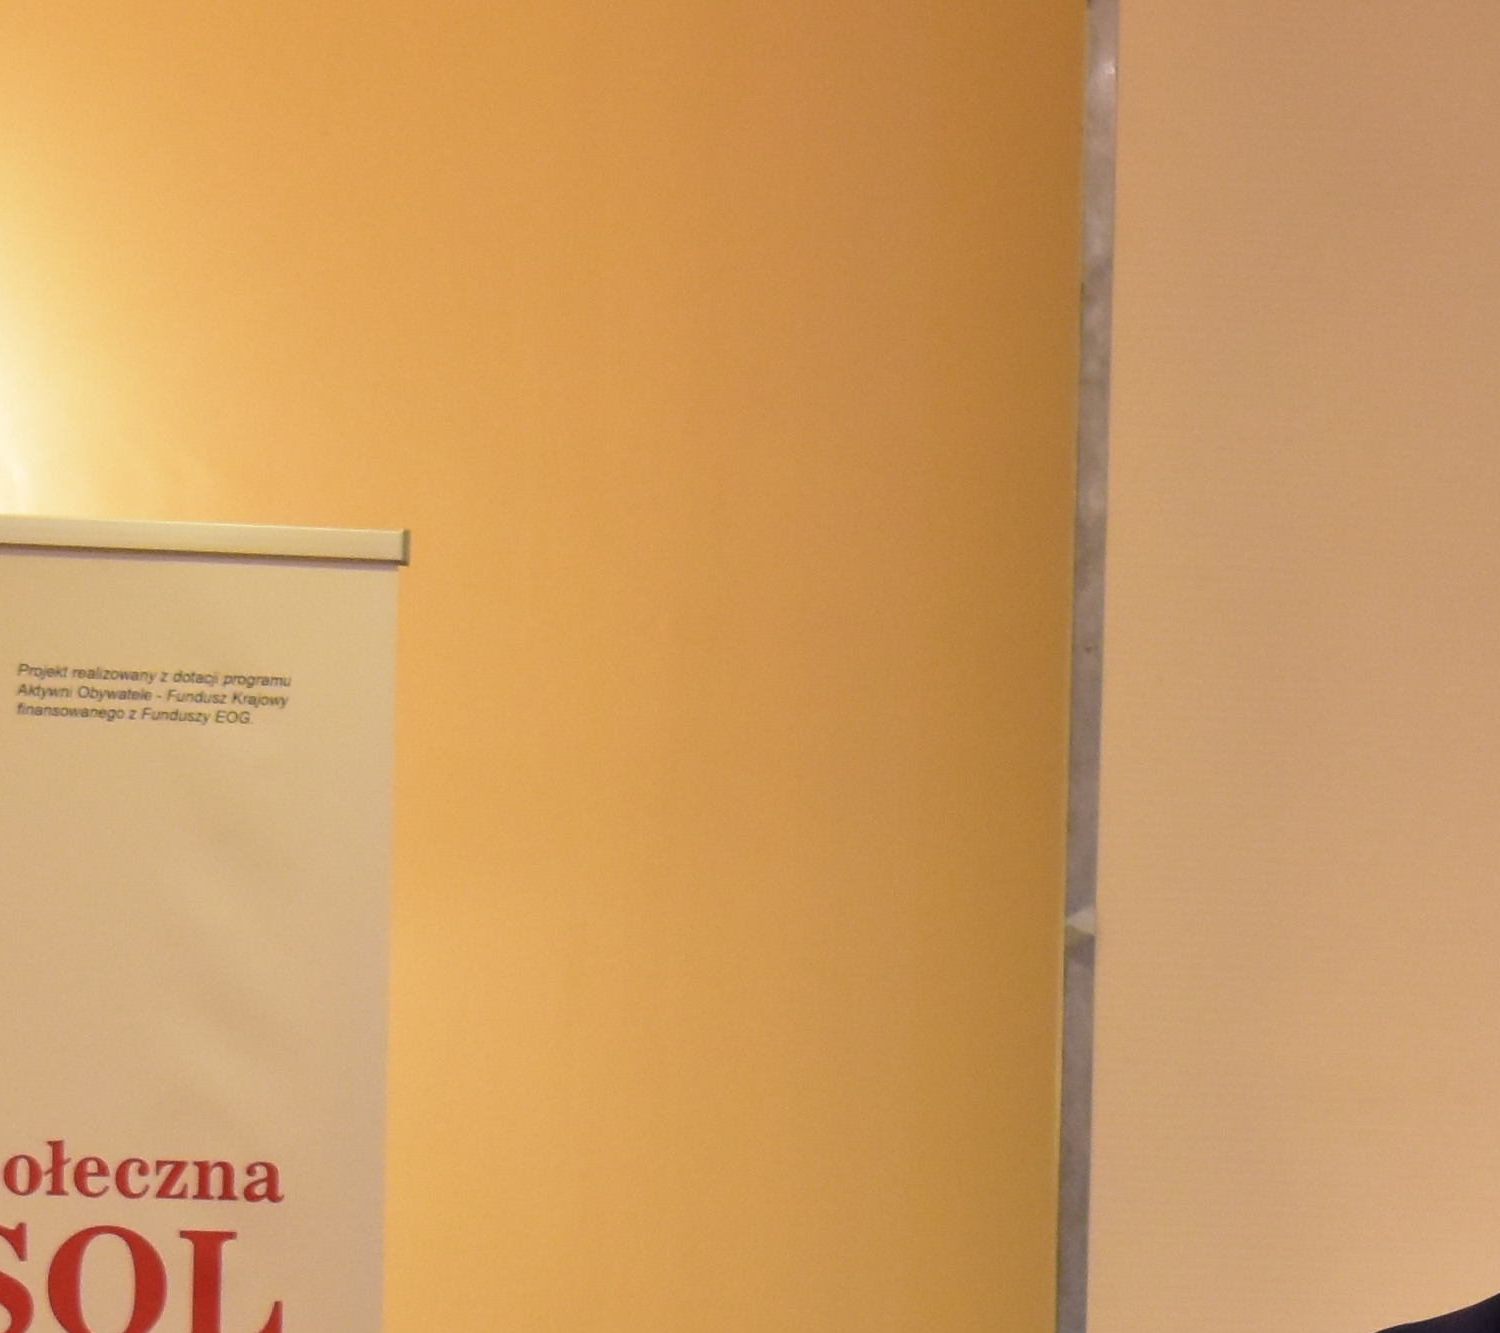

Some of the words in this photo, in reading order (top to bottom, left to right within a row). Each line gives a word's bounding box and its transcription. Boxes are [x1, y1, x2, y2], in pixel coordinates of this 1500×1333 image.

[18, 664, 67, 680] Projekt
[73, 667, 155, 684] realizowany
[160, 672, 167, 683] z
[174, 671, 219, 685] dotacji
[223, 673, 292, 688] programu
[18, 684, 73, 701] Aktywni
[78, 686, 152, 703] Obywatele
[167, 690, 227, 705] Fundusz
[232, 692, 290, 709] Krajowy
[17, 702, 124, 721] finansowanego
[129, 710, 137, 720] z
[141, 708, 210, 725] Funduszy
